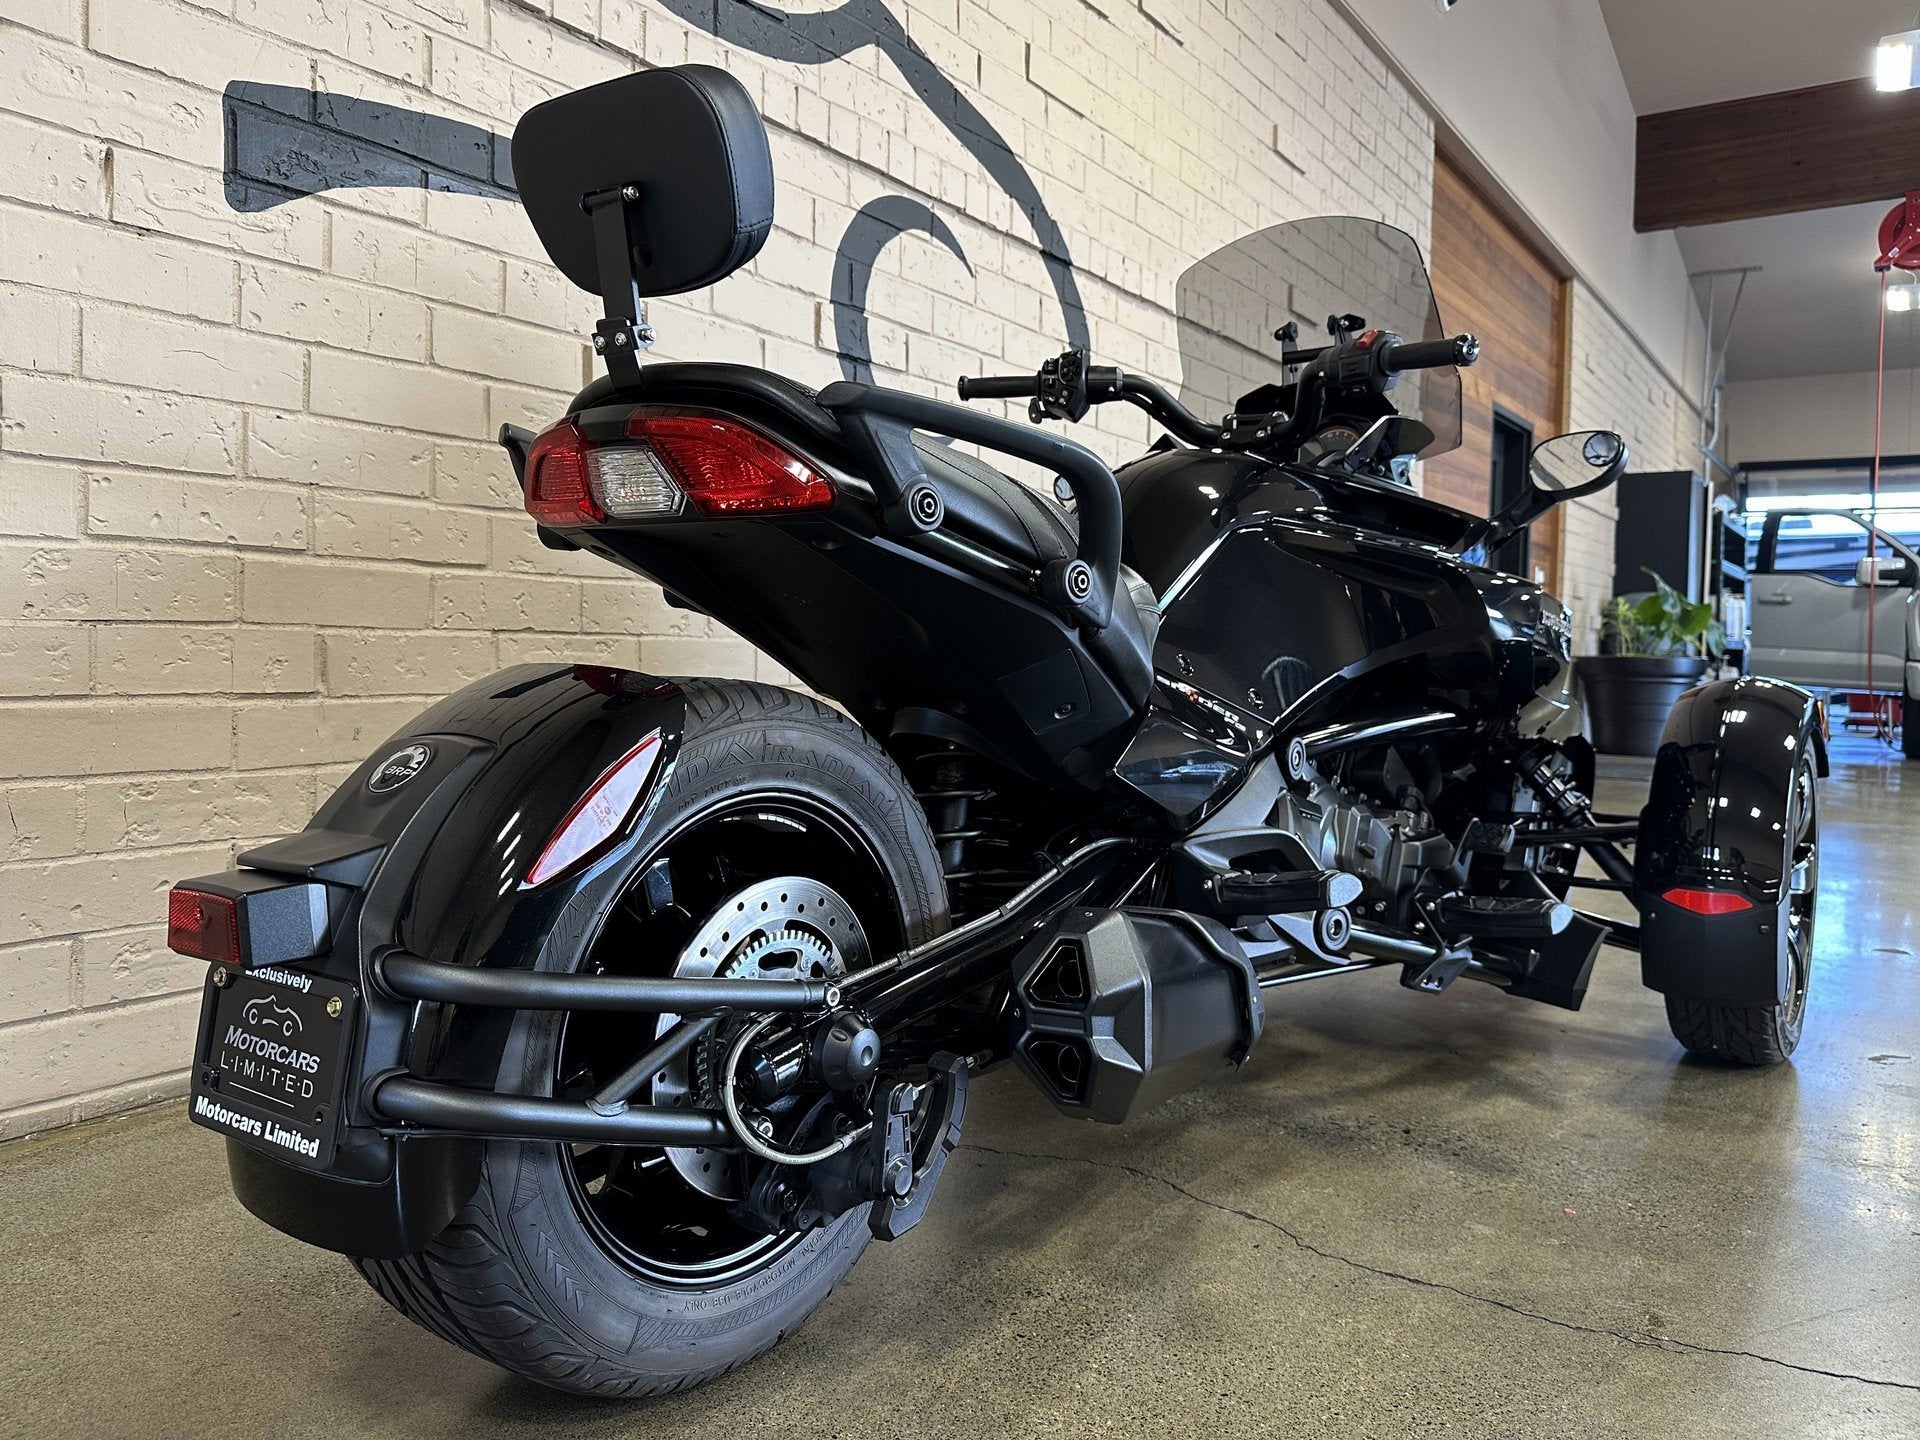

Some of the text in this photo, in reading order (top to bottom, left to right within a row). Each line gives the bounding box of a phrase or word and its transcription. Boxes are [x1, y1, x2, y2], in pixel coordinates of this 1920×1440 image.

[385, 765, 413, 776] BRP
[767, 744, 899, 817] RADIAL
[223, 1024, 321, 1074] MOTORCARS
[194, 1095, 321, 1158] Motorcars Limited
[735, 1256, 797, 1301] MOTORCYCLE
[683, 1301, 708, 1312] ONLY
[712, 1295, 732, 1308] USE
